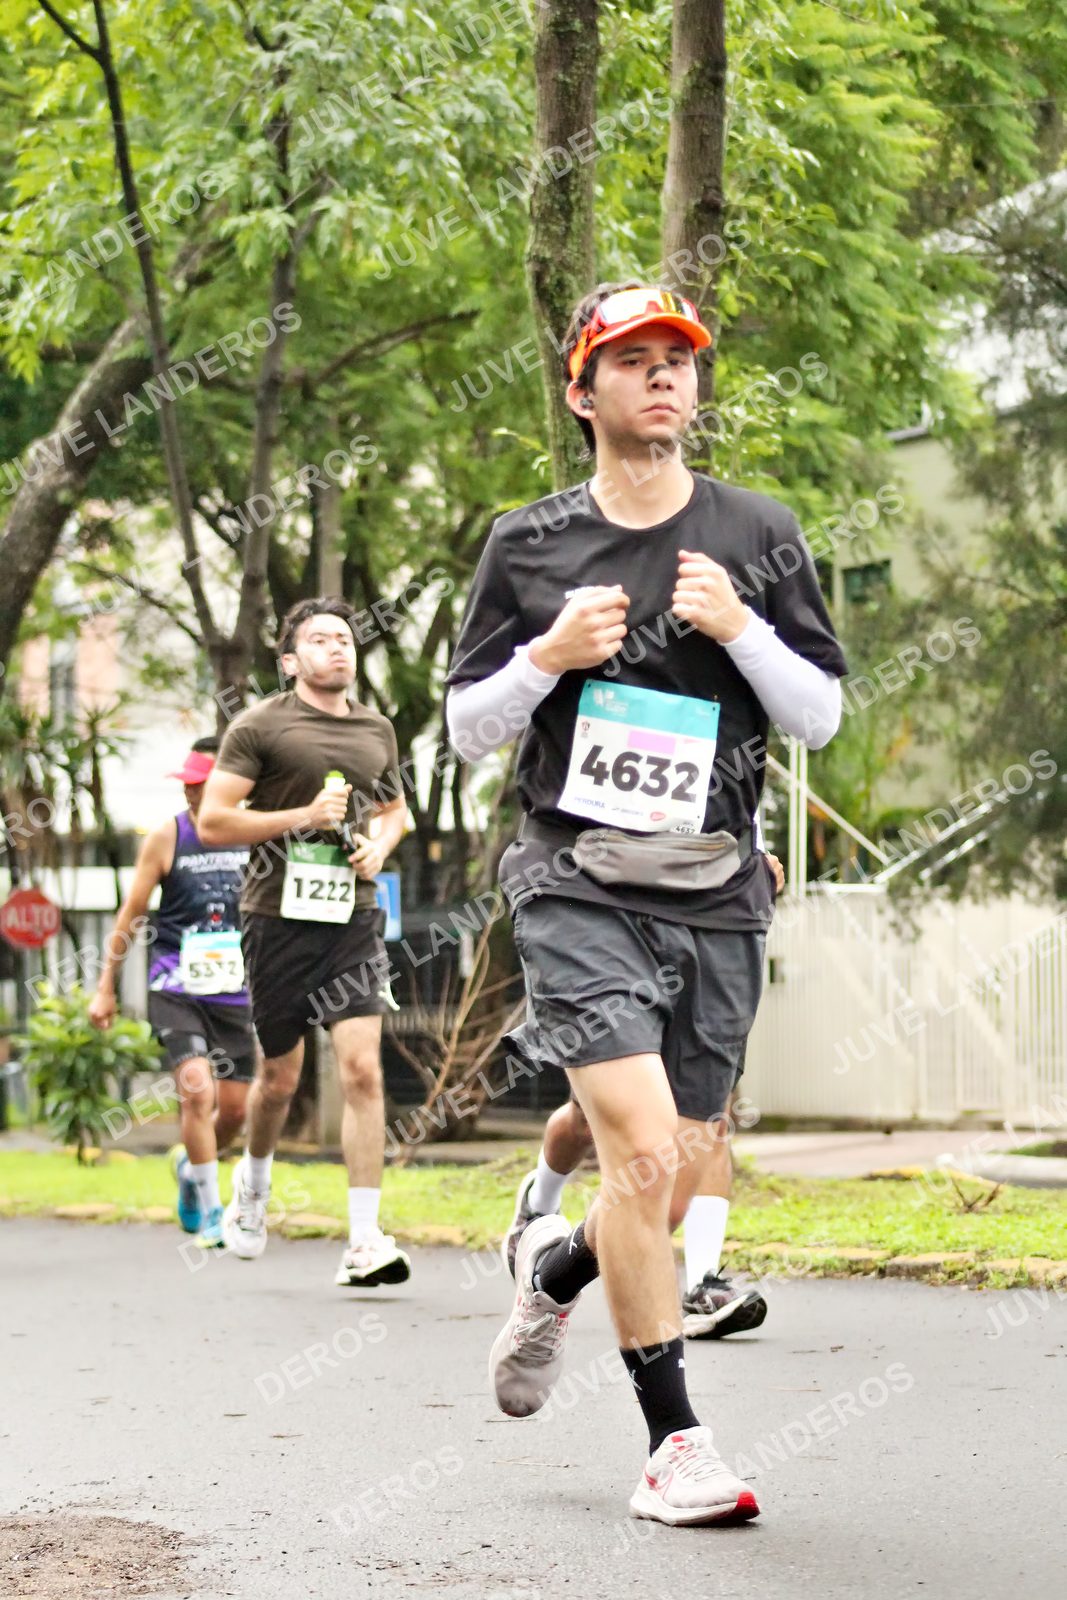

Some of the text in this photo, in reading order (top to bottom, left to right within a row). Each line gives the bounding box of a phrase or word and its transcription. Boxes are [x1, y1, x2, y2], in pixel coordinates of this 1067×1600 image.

[580, 744, 700, 803] 4632
[294, 877, 351, 902] 1222
[5, 904, 58, 931] ALTO
